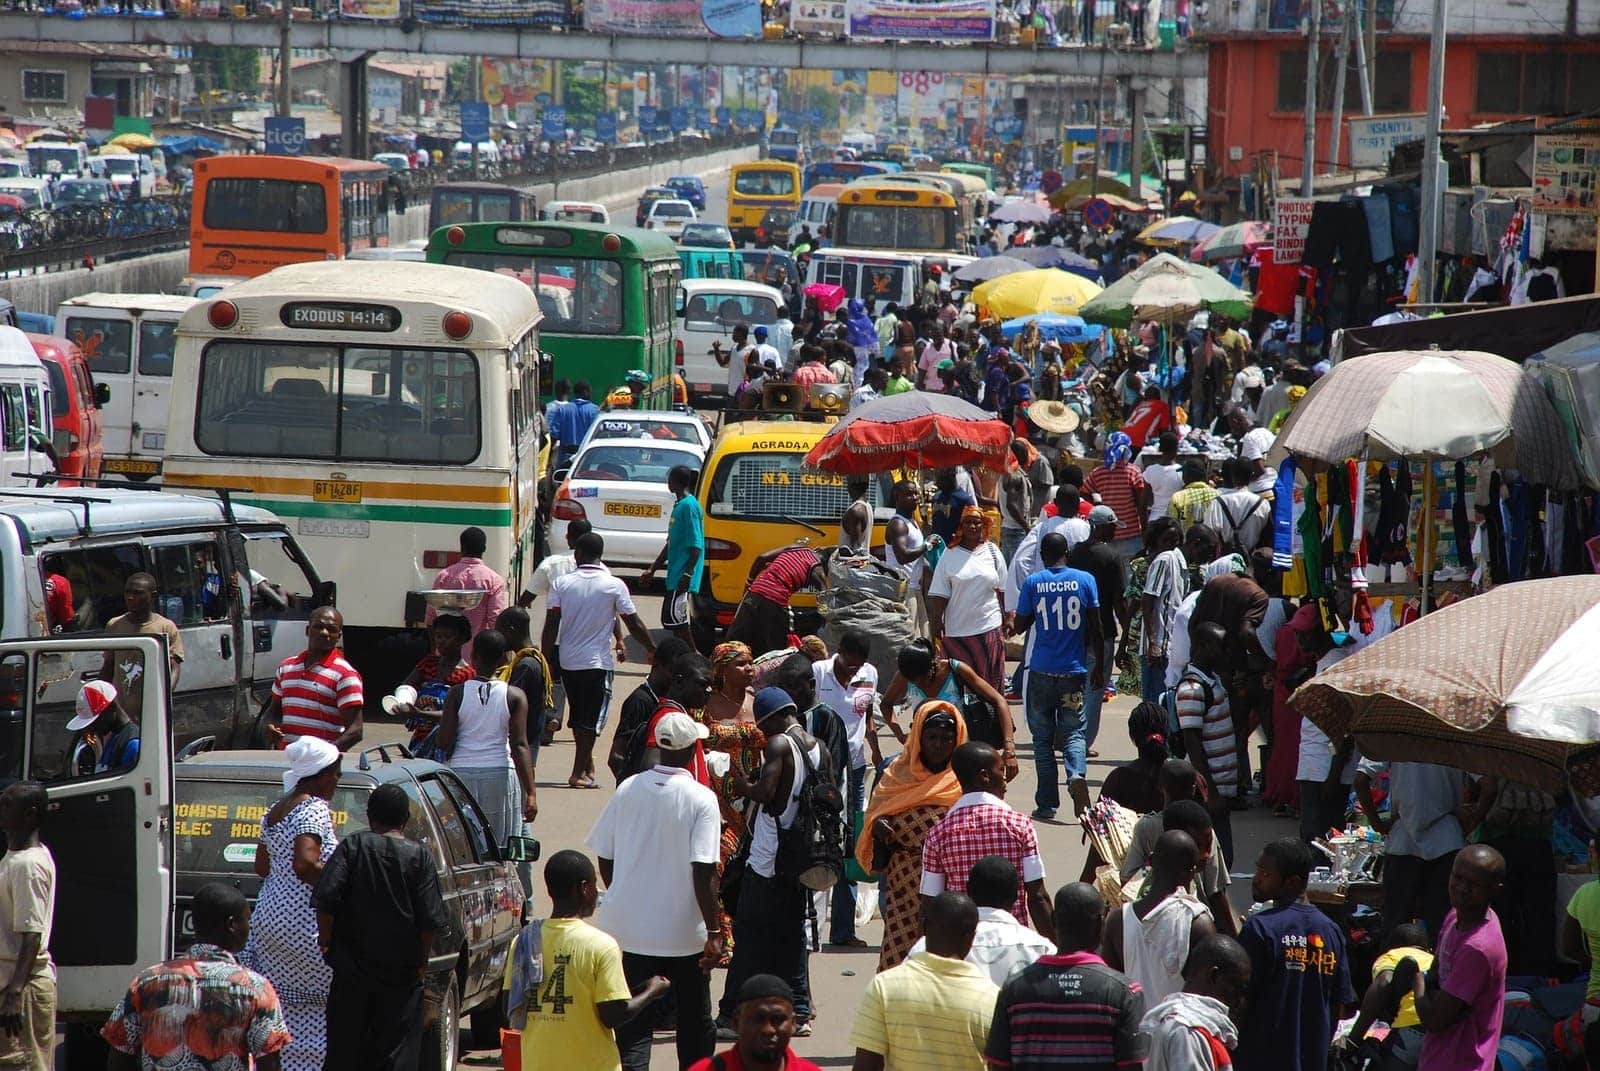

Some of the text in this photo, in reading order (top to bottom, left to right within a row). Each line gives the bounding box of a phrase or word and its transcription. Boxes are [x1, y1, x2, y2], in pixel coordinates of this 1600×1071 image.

[266, 127, 304, 153] tigo
[1276, 226, 1298, 237] FAX
[294, 309, 385, 325] EXODUS 14:14
[604, 421, 627, 430] TAXI
[751, 440, 810, 450] AGRADAA
[315, 482, 328, 495] GT
[606, 504, 621, 514] GE
[623, 505, 645, 515] 6031
[1036, 580, 1079, 593] MICCRO
[1036, 595, 1081, 630] 118
